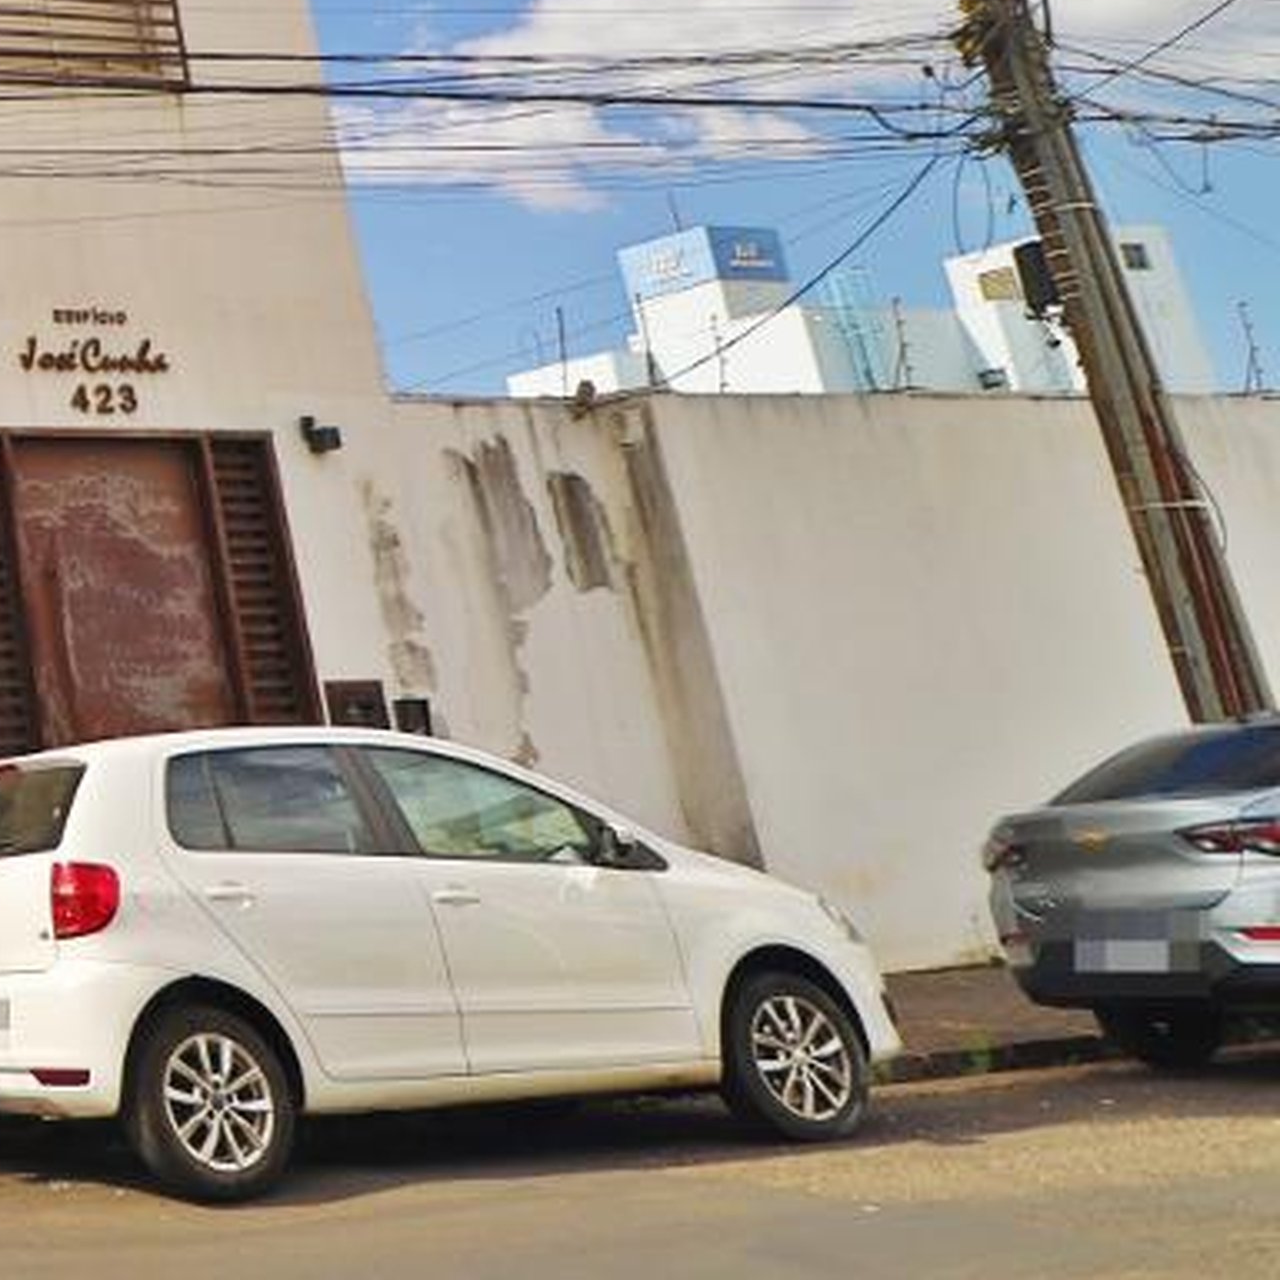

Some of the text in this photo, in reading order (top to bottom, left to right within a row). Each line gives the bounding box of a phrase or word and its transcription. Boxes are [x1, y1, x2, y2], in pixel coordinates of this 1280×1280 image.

[19, 336, 169, 372] José Cunha
[70, 383, 137, 415] 423
